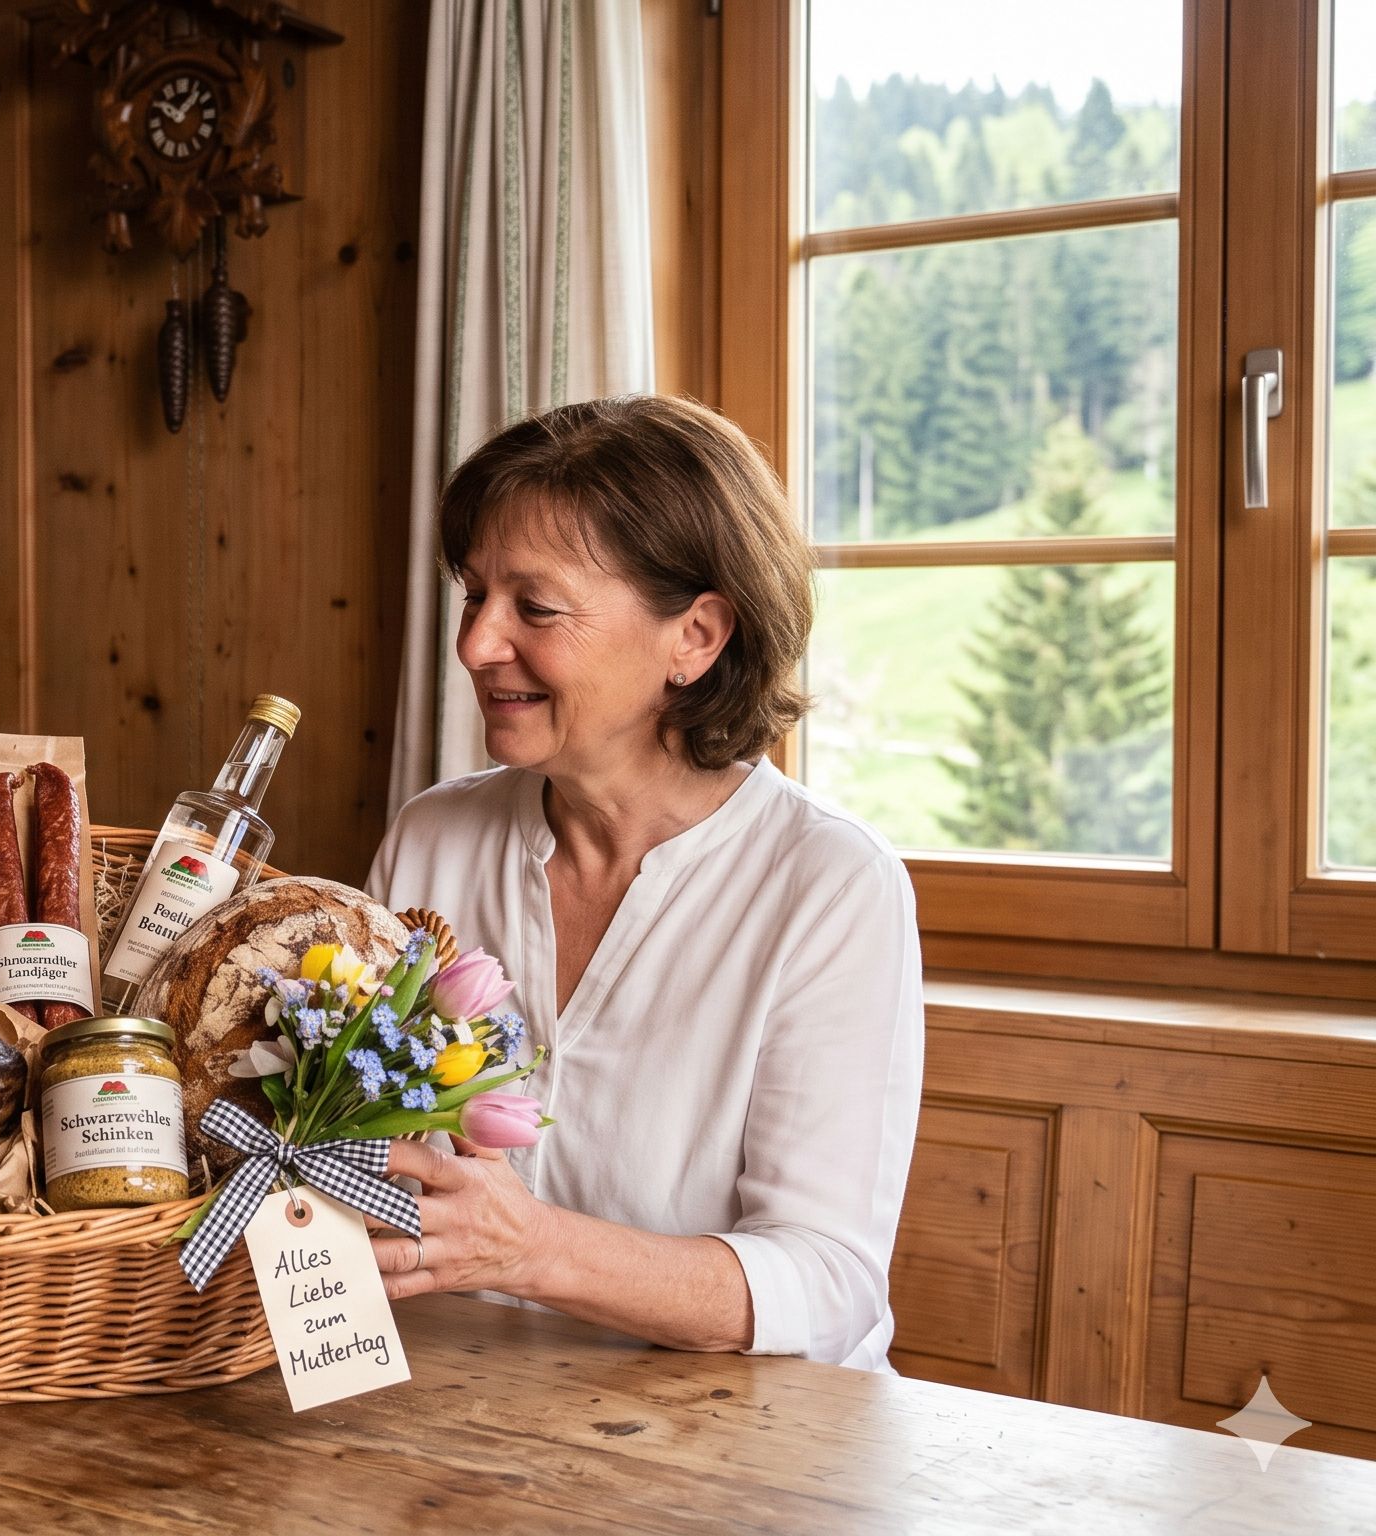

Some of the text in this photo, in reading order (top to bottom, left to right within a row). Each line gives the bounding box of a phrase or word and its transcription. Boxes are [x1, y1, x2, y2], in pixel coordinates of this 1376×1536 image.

[82, 1127, 154, 1144] Schinken
[274, 1249, 332, 1279] Alles
[289, 1277, 347, 1308] Liebe
[303, 1313, 347, 1334] zum
[289, 1332, 390, 1376] Muttertag
